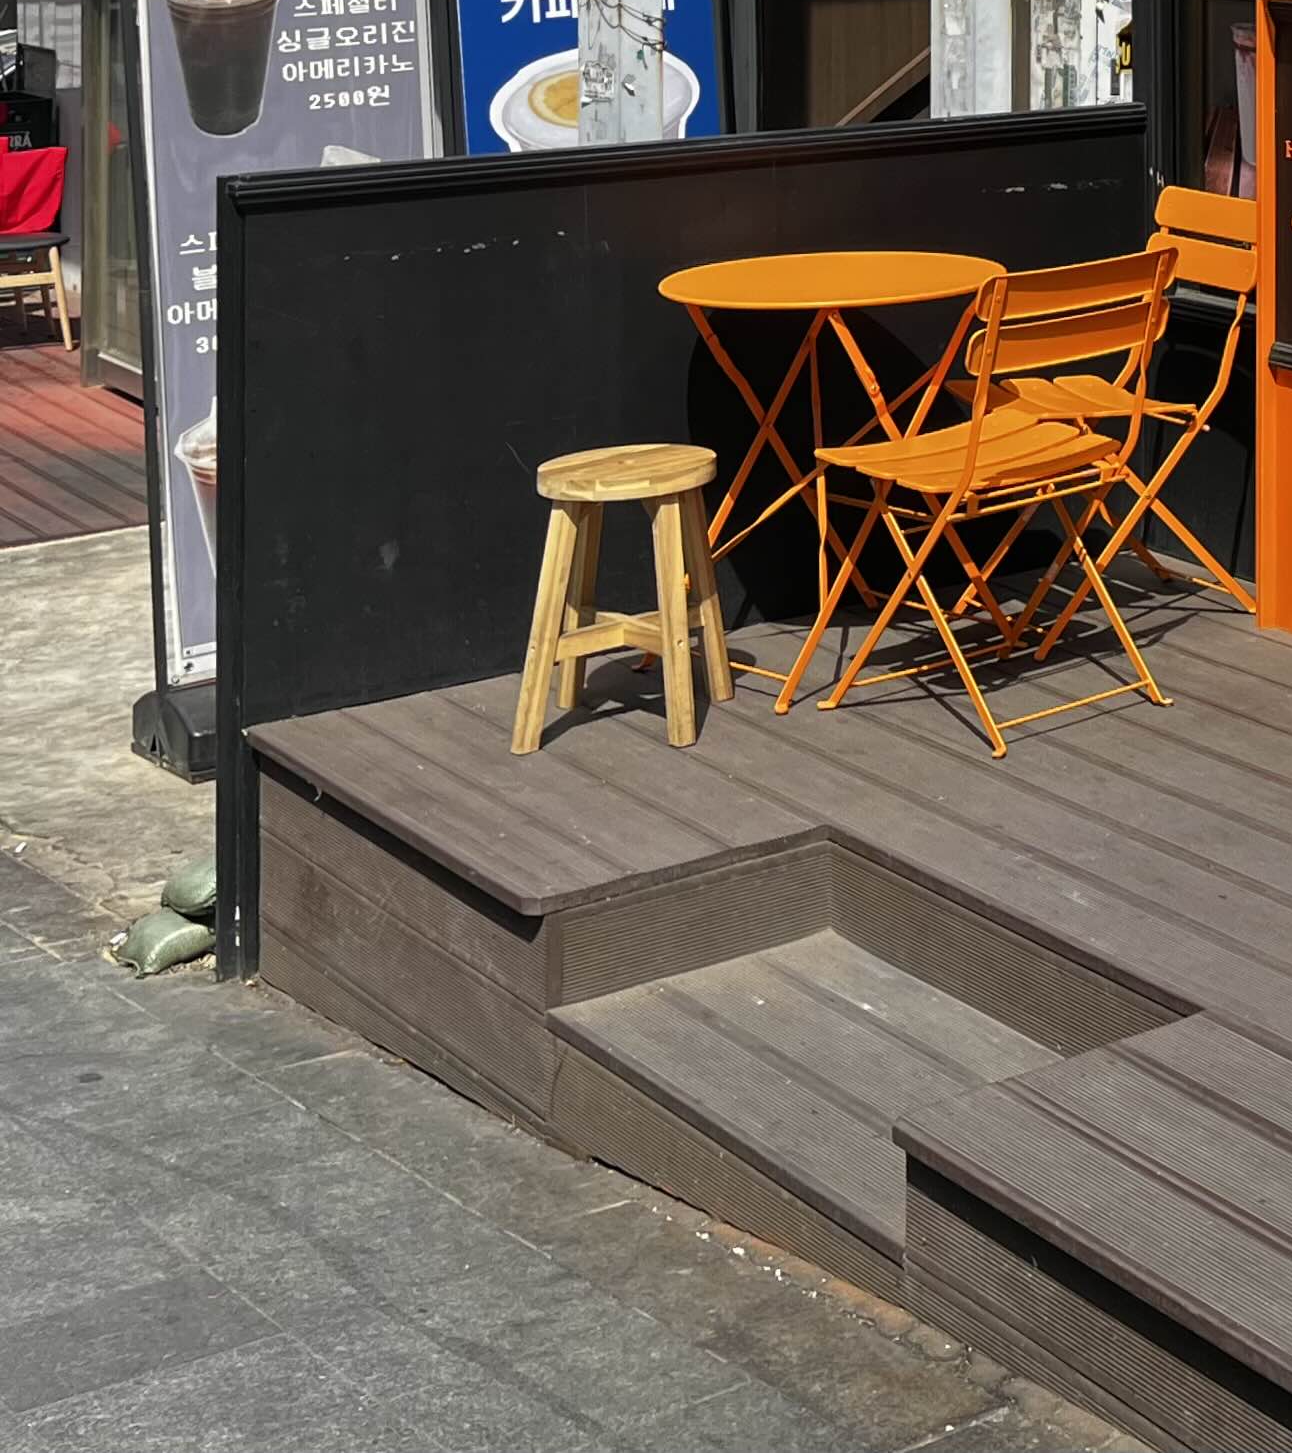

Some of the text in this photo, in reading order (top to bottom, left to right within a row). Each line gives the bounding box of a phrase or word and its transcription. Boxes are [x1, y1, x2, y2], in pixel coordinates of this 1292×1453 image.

[276, 20, 416, 53] 싱글오리진
[282, 54, 415, 82] 아메리카노
[308, 84, 391, 110] 2500원
